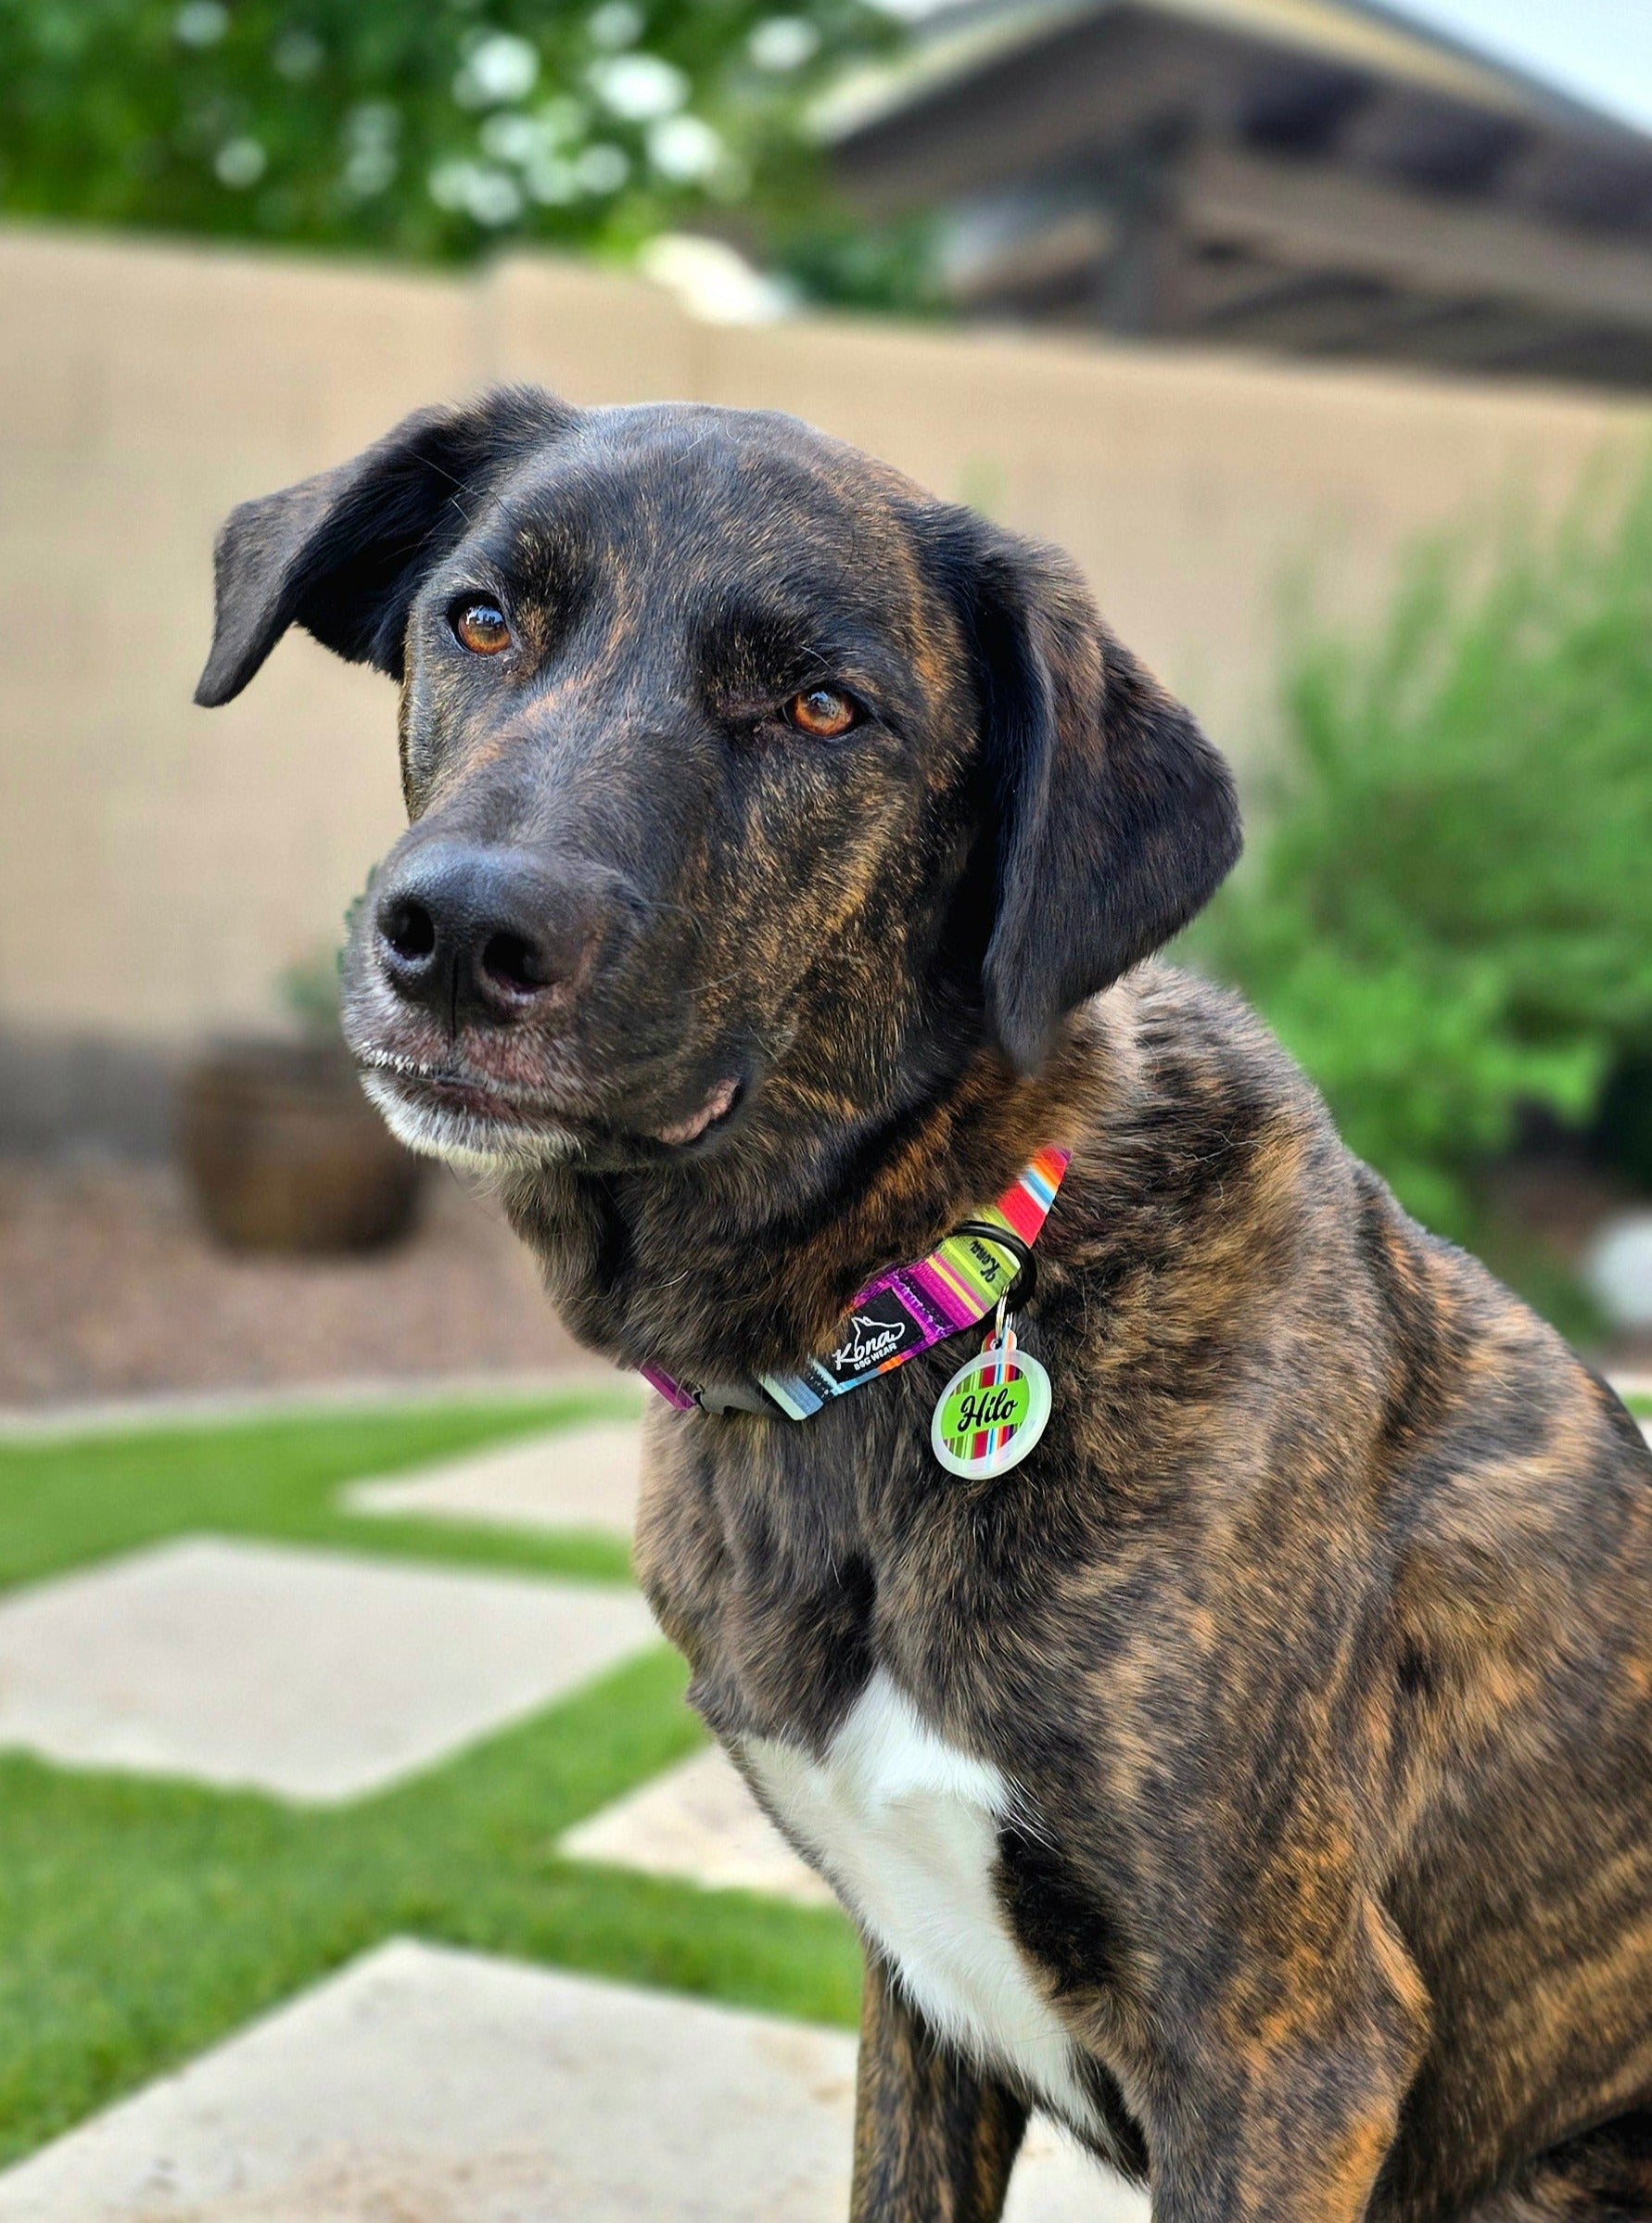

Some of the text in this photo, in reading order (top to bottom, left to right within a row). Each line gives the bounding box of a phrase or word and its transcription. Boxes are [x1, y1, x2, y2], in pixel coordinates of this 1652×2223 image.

[970, 1240, 1000, 1283] Kona
[832, 1329, 897, 1371] Kona
[853, 1342, 897, 1371] DOG WEAR
[957, 1387, 1019, 1432] Hilo
